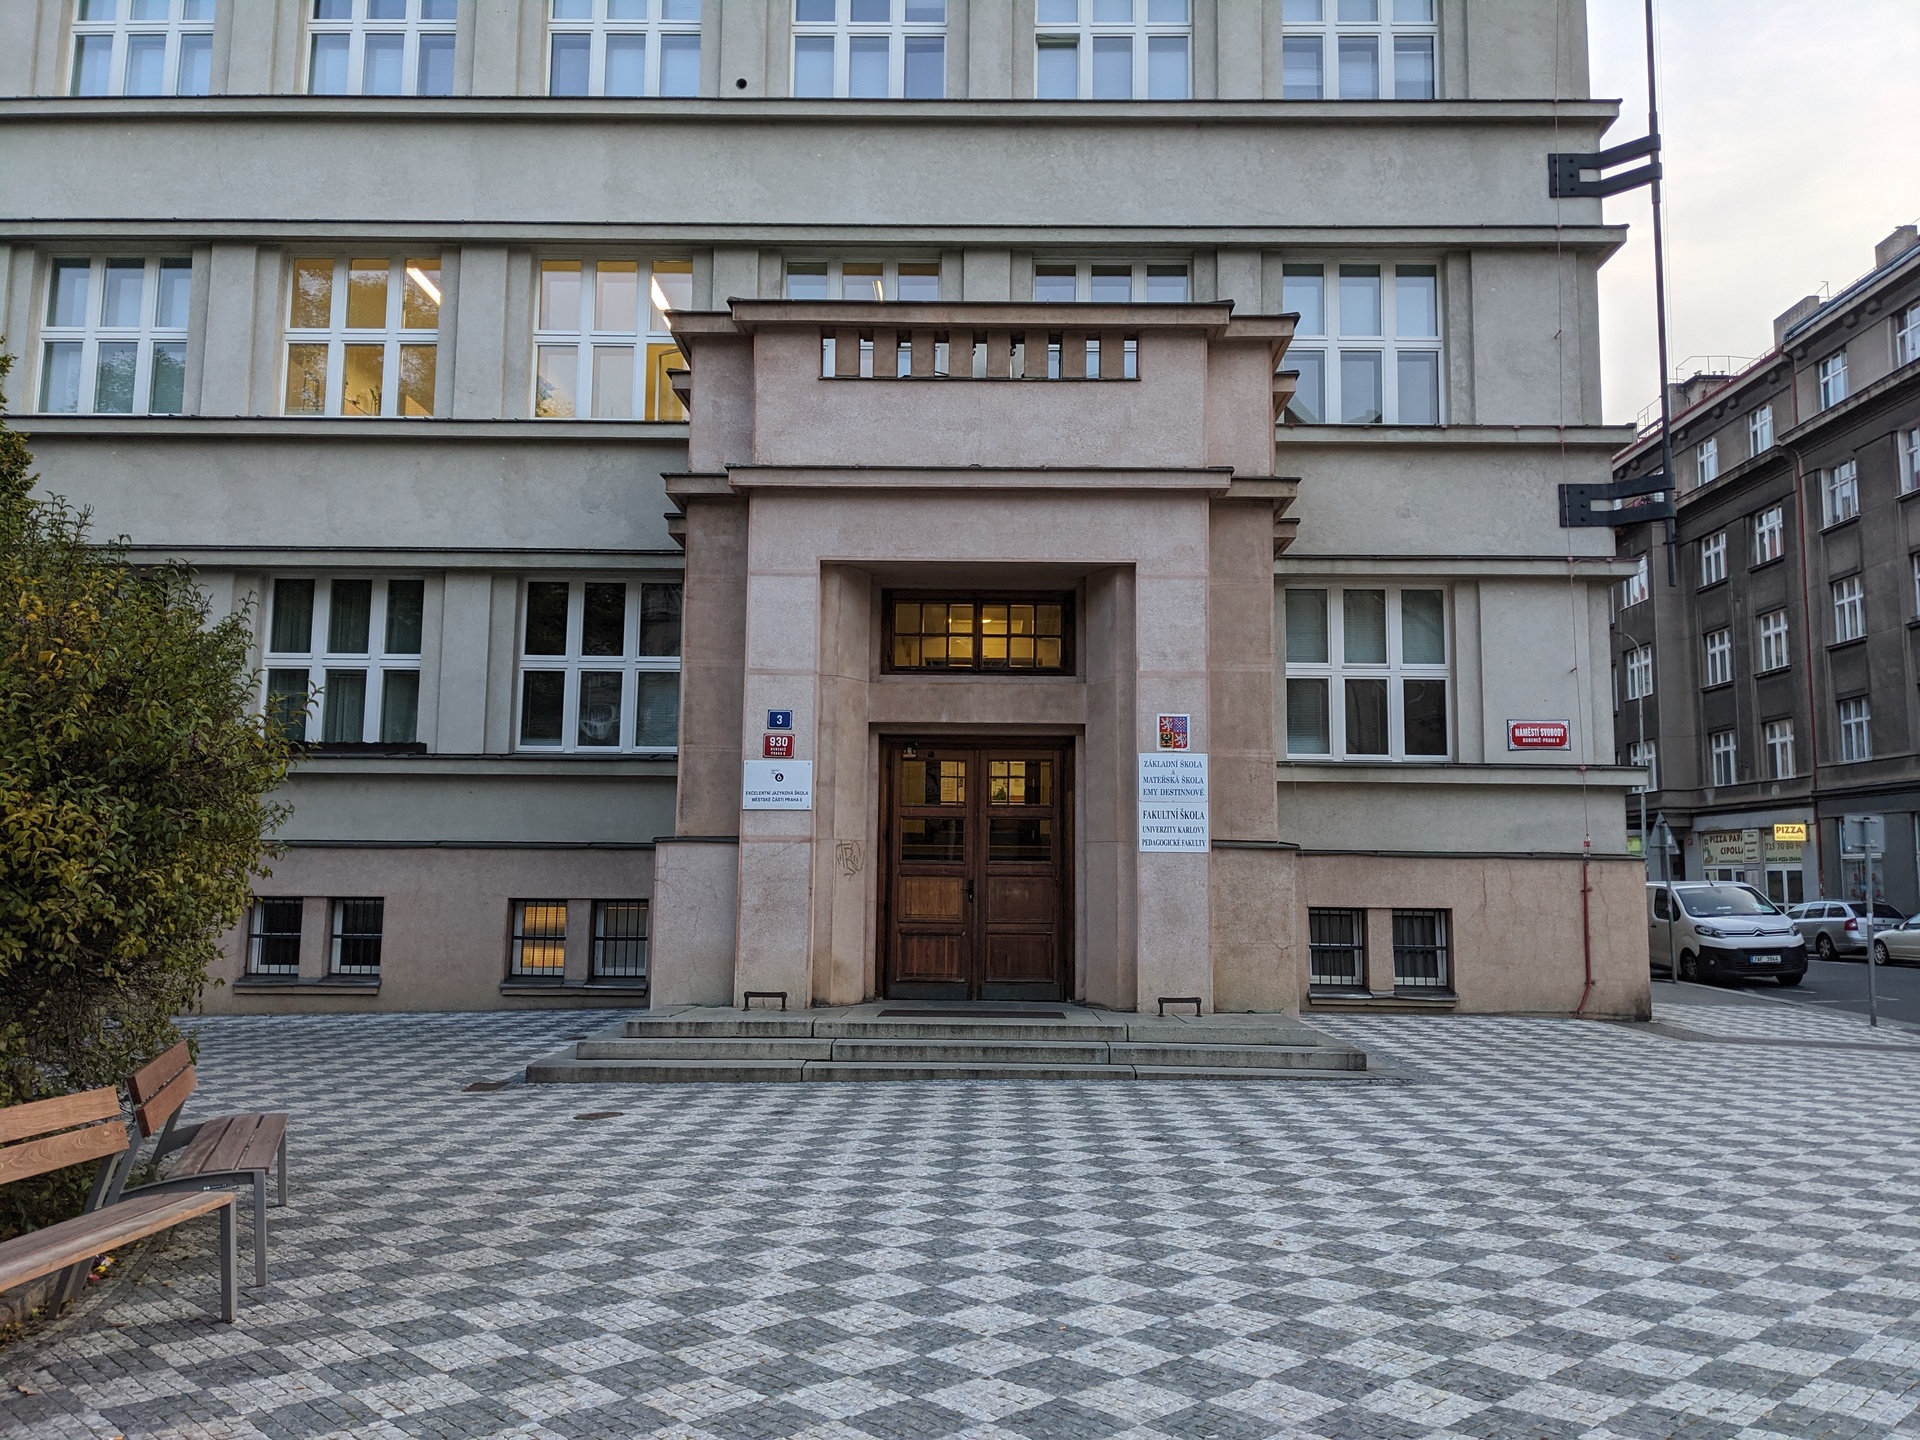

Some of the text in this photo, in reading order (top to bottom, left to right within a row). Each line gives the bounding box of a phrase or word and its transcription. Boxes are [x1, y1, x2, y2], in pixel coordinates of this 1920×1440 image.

[776, 714, 783, 725] 3
[1515, 726, 1564, 737] NÁMĚSTÍ SVOBODY
[769, 736, 788, 747] 930
[1143, 758, 1203, 769] ZÁKLADNÍ ŠKOLA
[1143, 775, 1204, 785] MATEŘSKÁ ŠKOLA
[1143, 787, 1205, 796] EMY DESTINNOVÉ
[1143, 807, 1205, 820] FAKULTNÍ ŠKOLA
[1142, 825, 1206, 834] UNIVERZITY KARLOVY
[1775, 826, 1804, 834] PIZZA
[1142, 837, 1206, 847] PEDAGOGICKÉ FAKULTY
[1709, 834, 1728, 844] PIZZA
